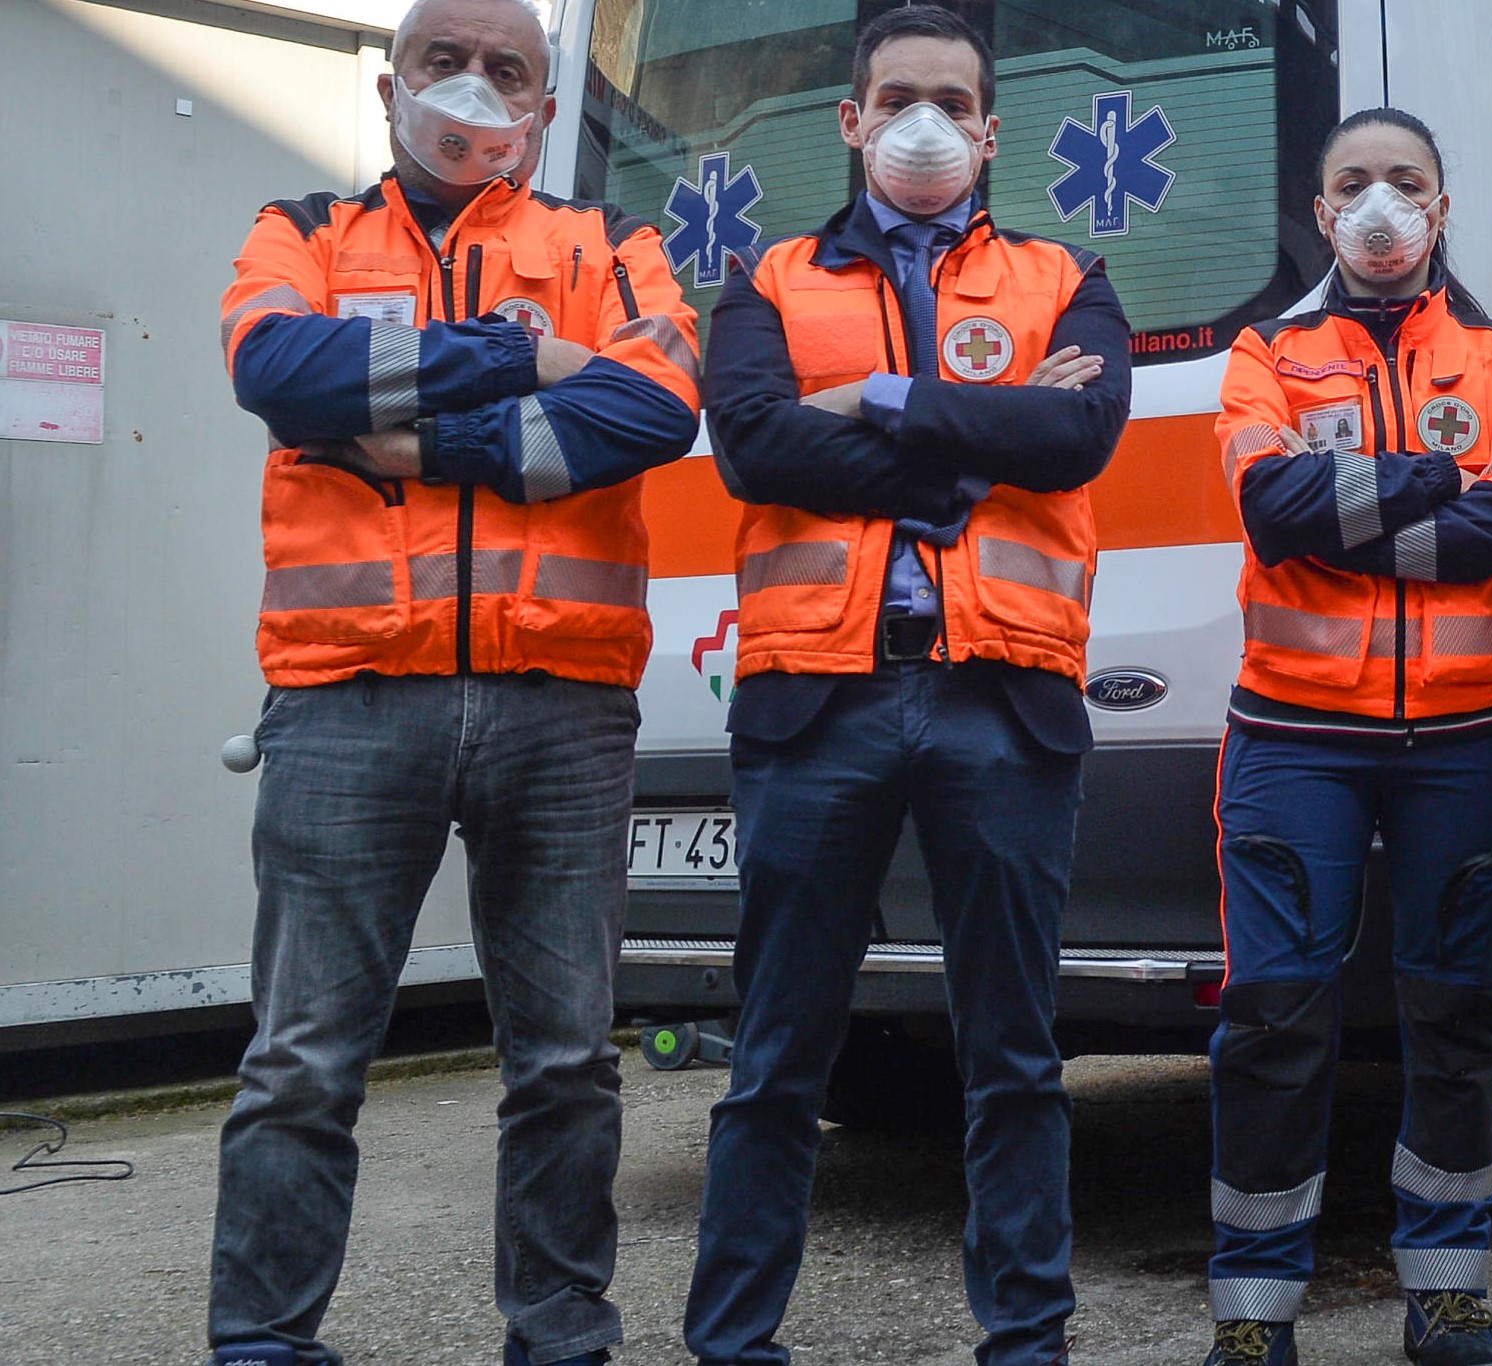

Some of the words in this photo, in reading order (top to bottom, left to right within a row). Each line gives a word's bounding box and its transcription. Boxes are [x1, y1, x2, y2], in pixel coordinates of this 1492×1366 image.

[56, 333, 99, 348] FUMARE
[1128, 326, 1214, 353] ilano.it
[49, 348, 87, 362] USARE
[9, 360, 54, 375] FIAMME
[58, 364, 99, 379] LIBERE
[1427, 401, 1451, 414] CROCE
[1453, 402, 1473, 420] D'ORO
[1432, 441, 1462, 451] MILANO
[1099, 679, 1144, 699] Ford
[685, 818, 739, 869] 43
